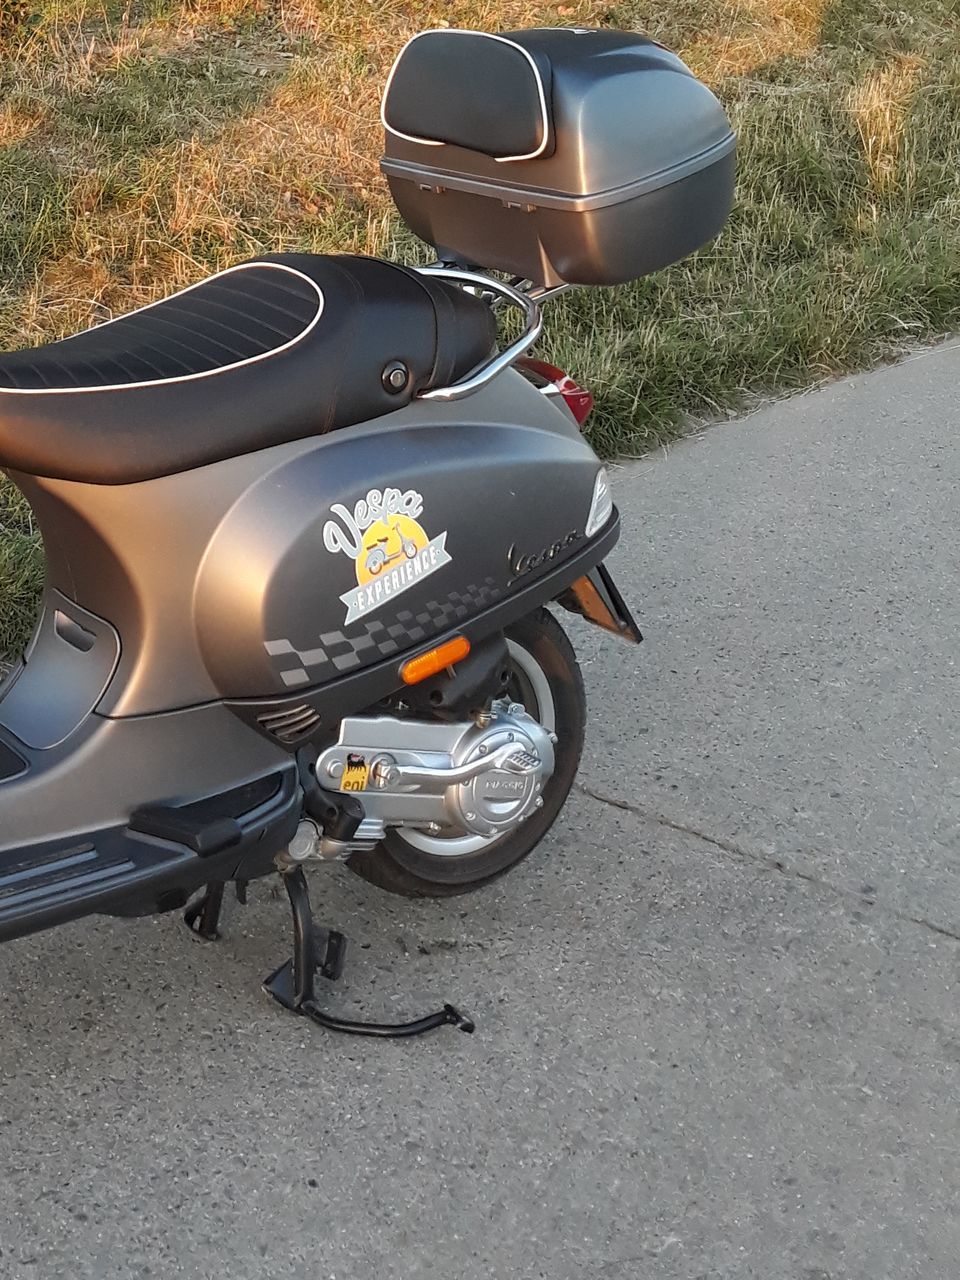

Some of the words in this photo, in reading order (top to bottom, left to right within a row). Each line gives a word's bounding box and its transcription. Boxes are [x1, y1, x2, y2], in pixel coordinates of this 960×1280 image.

[323, 488, 423, 559] Vespa
[357, 546, 437, 611] EXPERIENCE
[343, 776, 364, 791] eni
